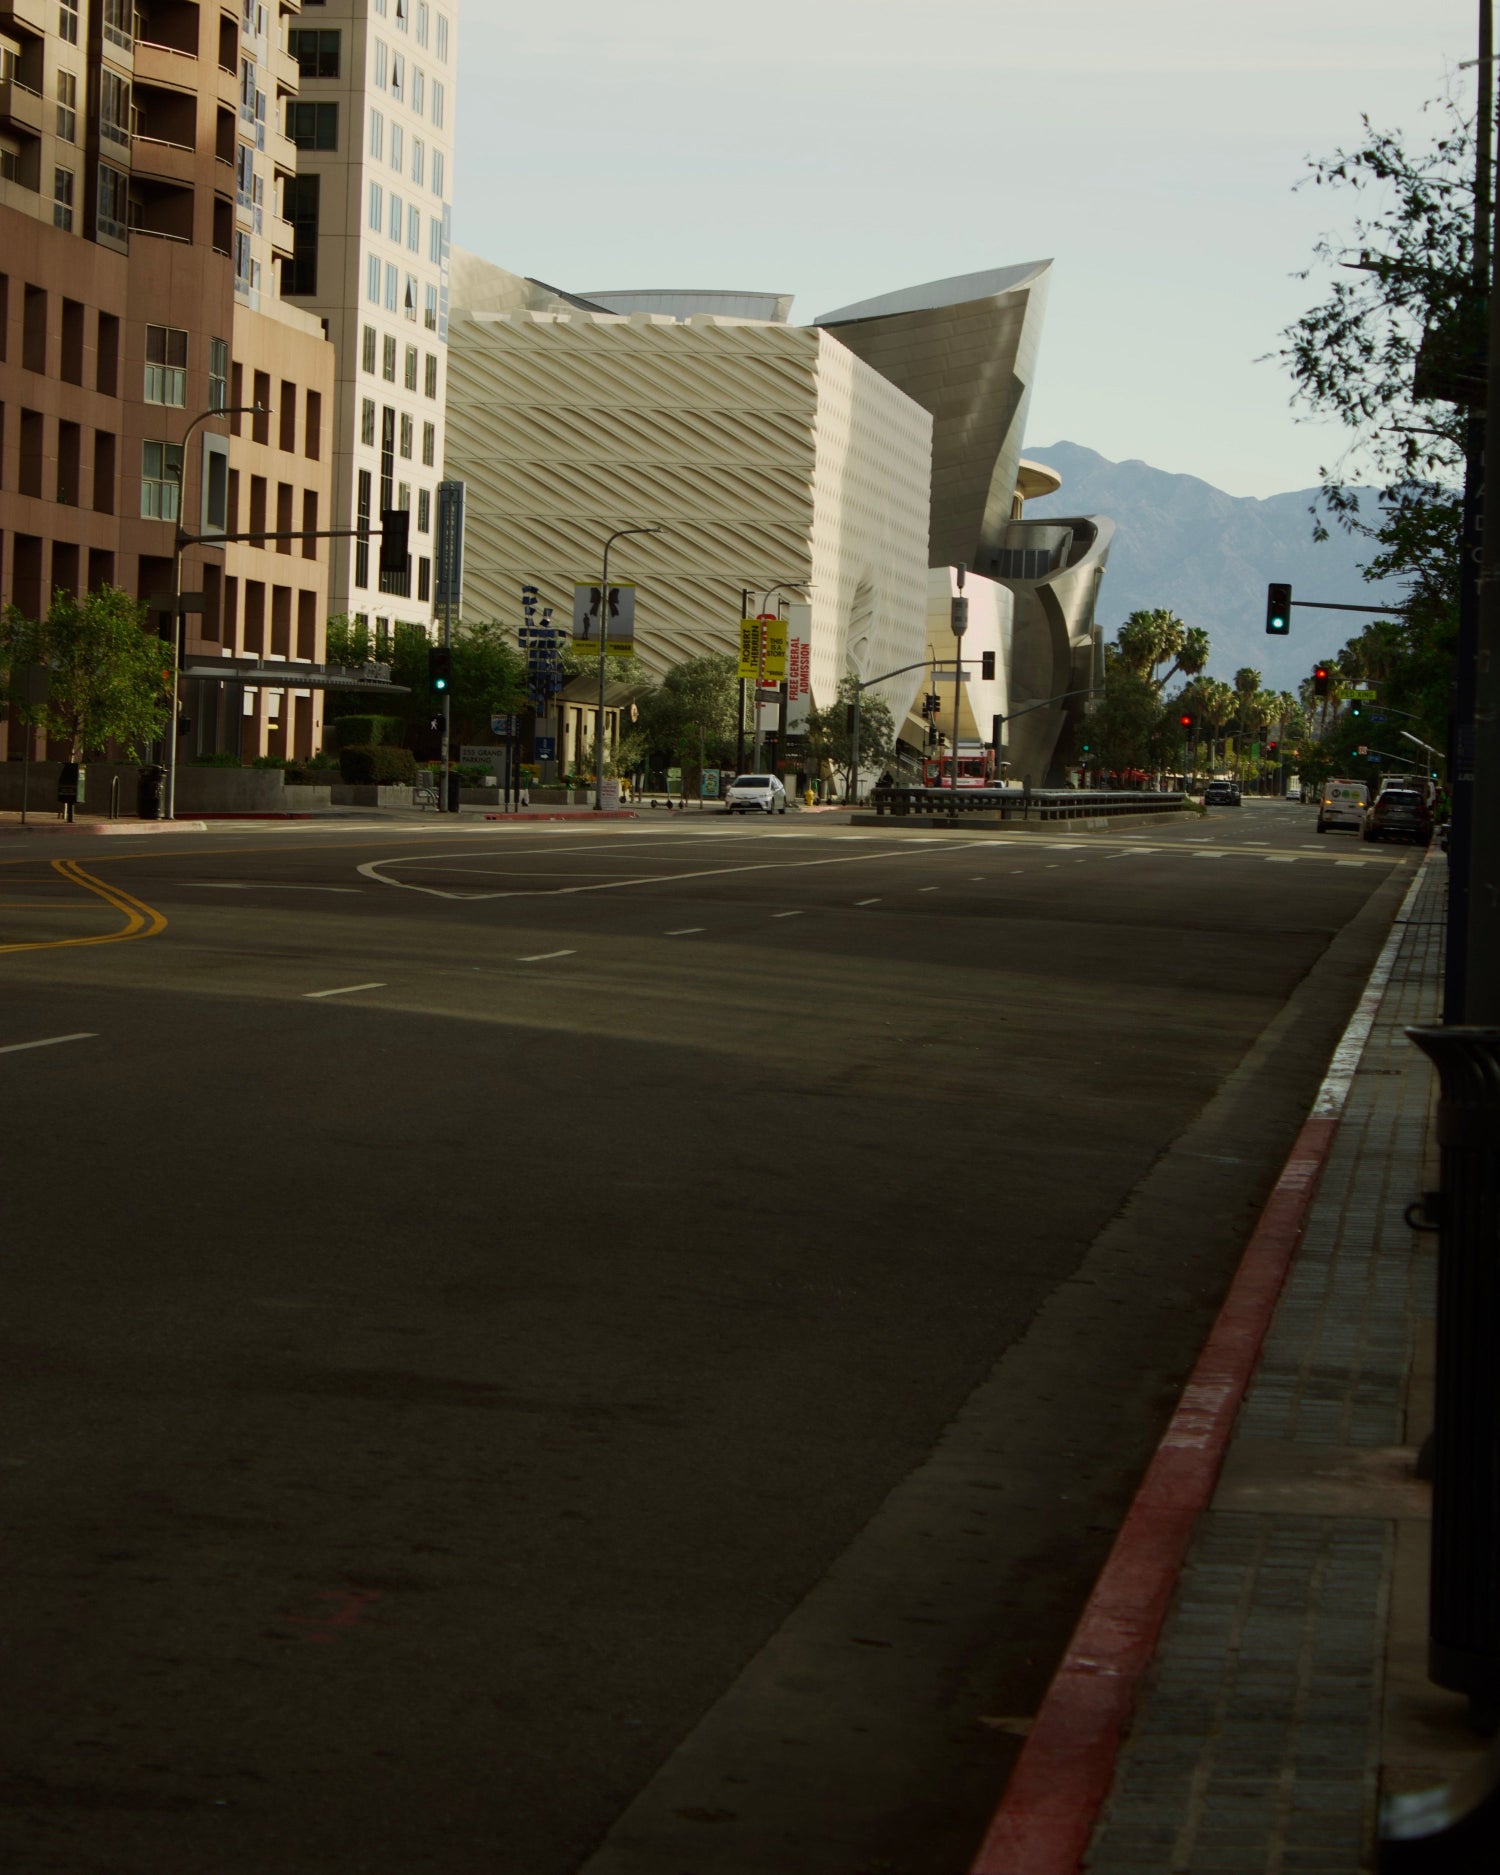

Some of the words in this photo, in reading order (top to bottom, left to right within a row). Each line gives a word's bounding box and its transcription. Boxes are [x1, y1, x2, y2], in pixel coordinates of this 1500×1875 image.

[742, 629, 751, 663] ROBERT
[750, 625, 759, 667] THERRIEN
[789, 637, 800, 678] GENERAL
[799, 643, 810, 695] ADMISSION
[789, 678, 799, 701] FREE
[462, 756, 492, 764] PARKING
[477, 749, 502, 757] GRAND
